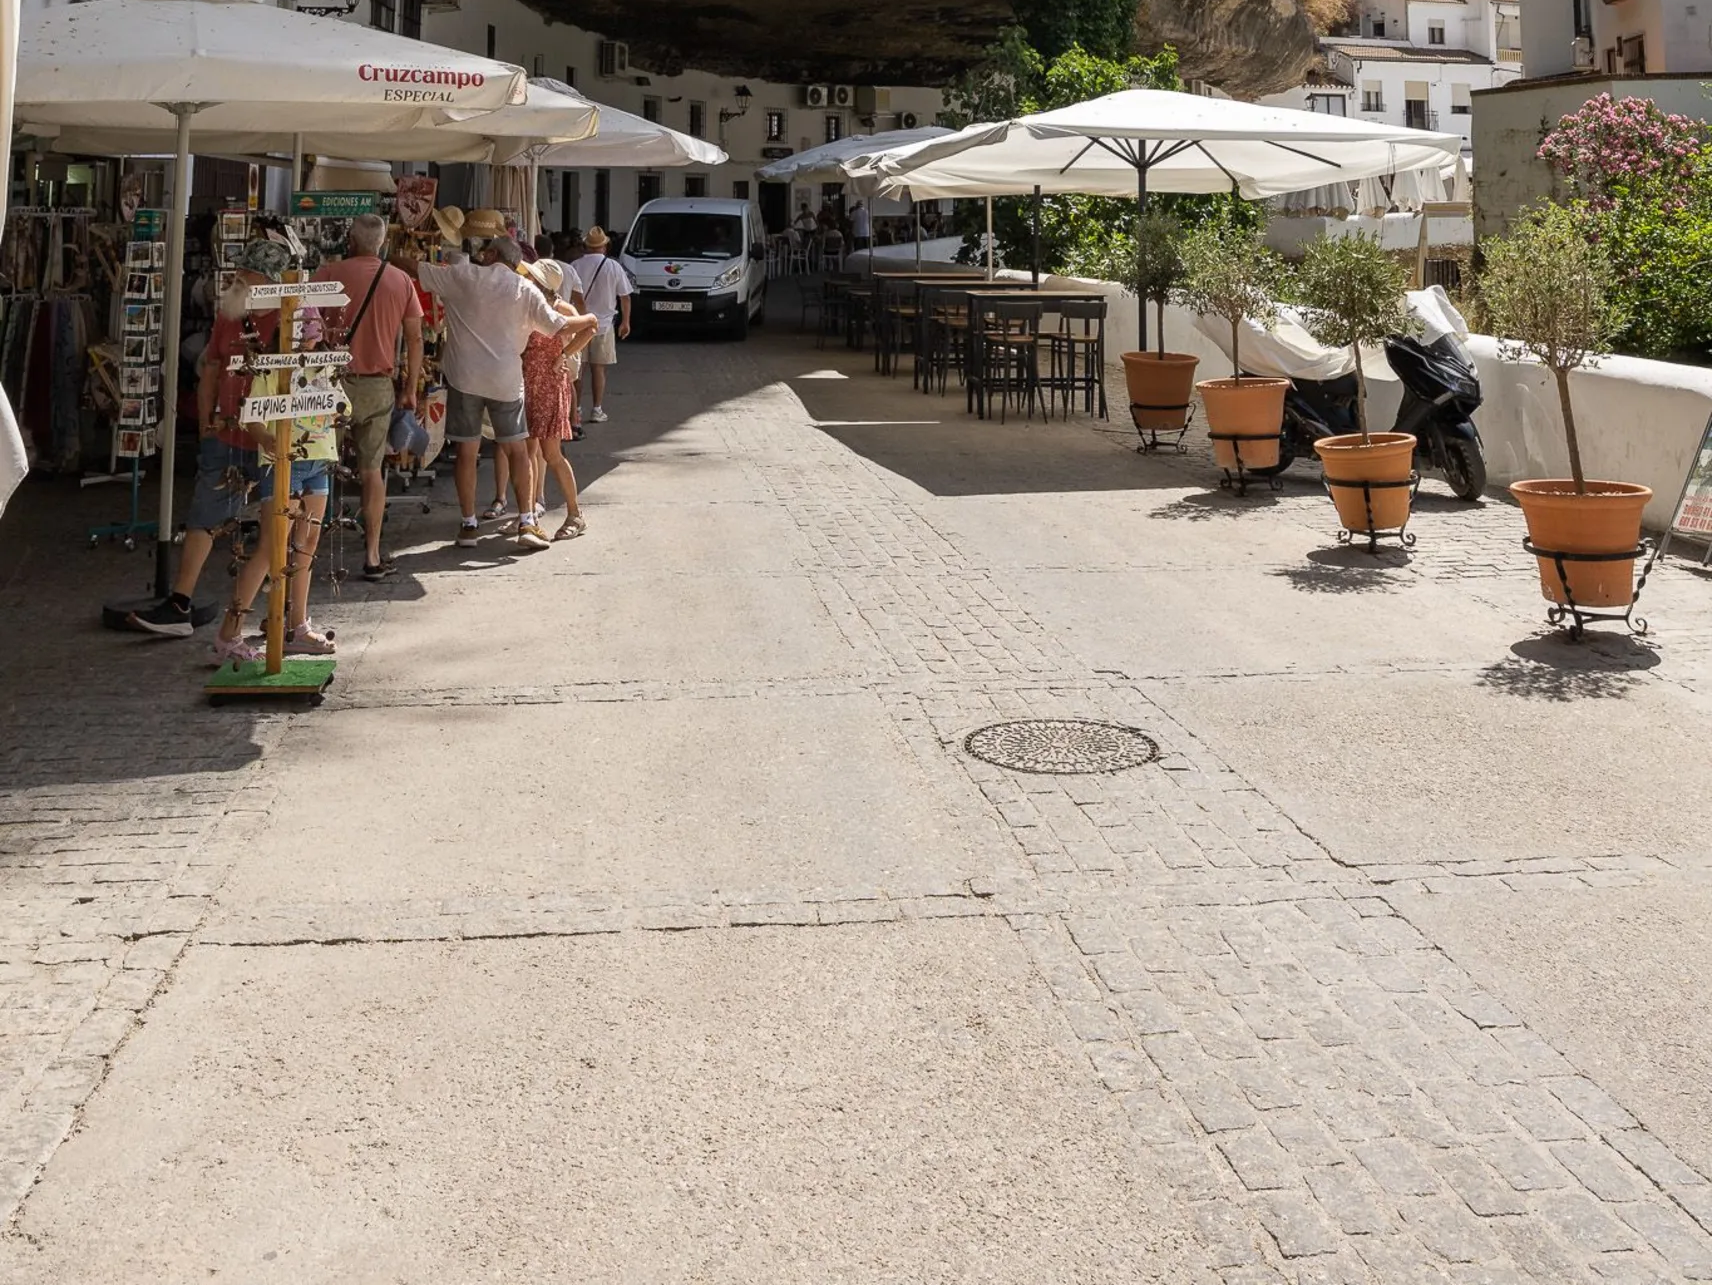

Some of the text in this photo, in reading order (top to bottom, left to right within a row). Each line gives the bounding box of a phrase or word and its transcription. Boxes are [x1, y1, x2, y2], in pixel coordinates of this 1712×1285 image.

[358, 64, 485, 89] Cruzcampo
[384, 89, 455, 103] ESPECIAL
[322, 197, 359, 206] EDICIONES
[251, 394, 334, 420] FLYING ANIMALS
